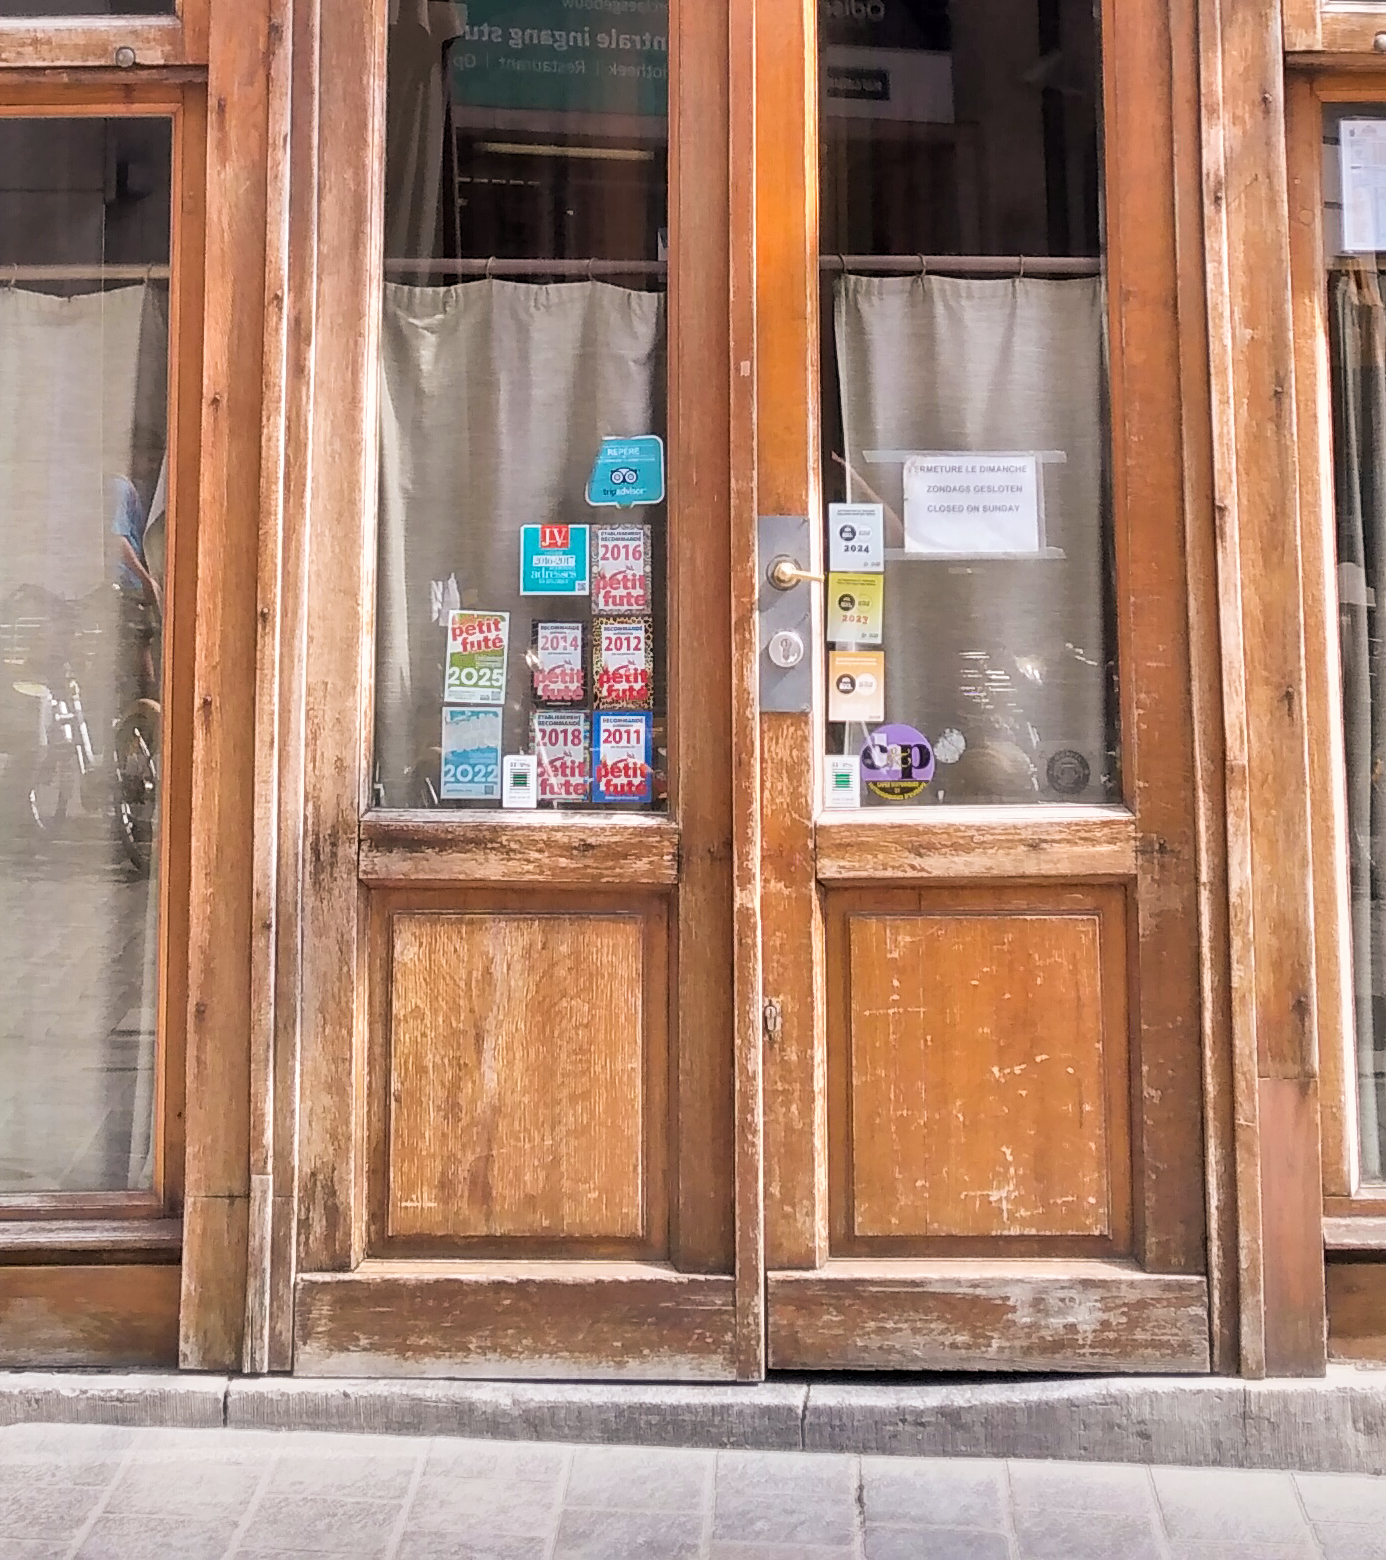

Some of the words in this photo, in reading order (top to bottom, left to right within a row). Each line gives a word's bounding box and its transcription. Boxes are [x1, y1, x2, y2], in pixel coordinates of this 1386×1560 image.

[965, 465, 977, 473] LE
[979, 464, 1027, 473] DIMANCHE
[926, 485, 971, 493] ZONDAGS
[973, 484, 1023, 493] GESLOTEN
[927, 504, 964, 513] CLOSED
[966, 504, 980, 512] ON
[982, 504, 1021, 513] SUNDAY
[600, 544, 642, 561] 2016
[844, 544, 870, 554] 2024
[595, 573, 646, 596] petit
[451, 617, 502, 642] petit
[461, 634, 504, 653] futé
[604, 636, 642, 652] 2012
[449, 666, 503, 687] 2025
[533, 667, 584, 688] petit
[598, 667, 648, 688] petit
[536, 728, 582, 747] 2018
[602, 729, 641, 744] 2011
[444, 764, 498, 782] 2022
[596, 760, 647, 782] petit
